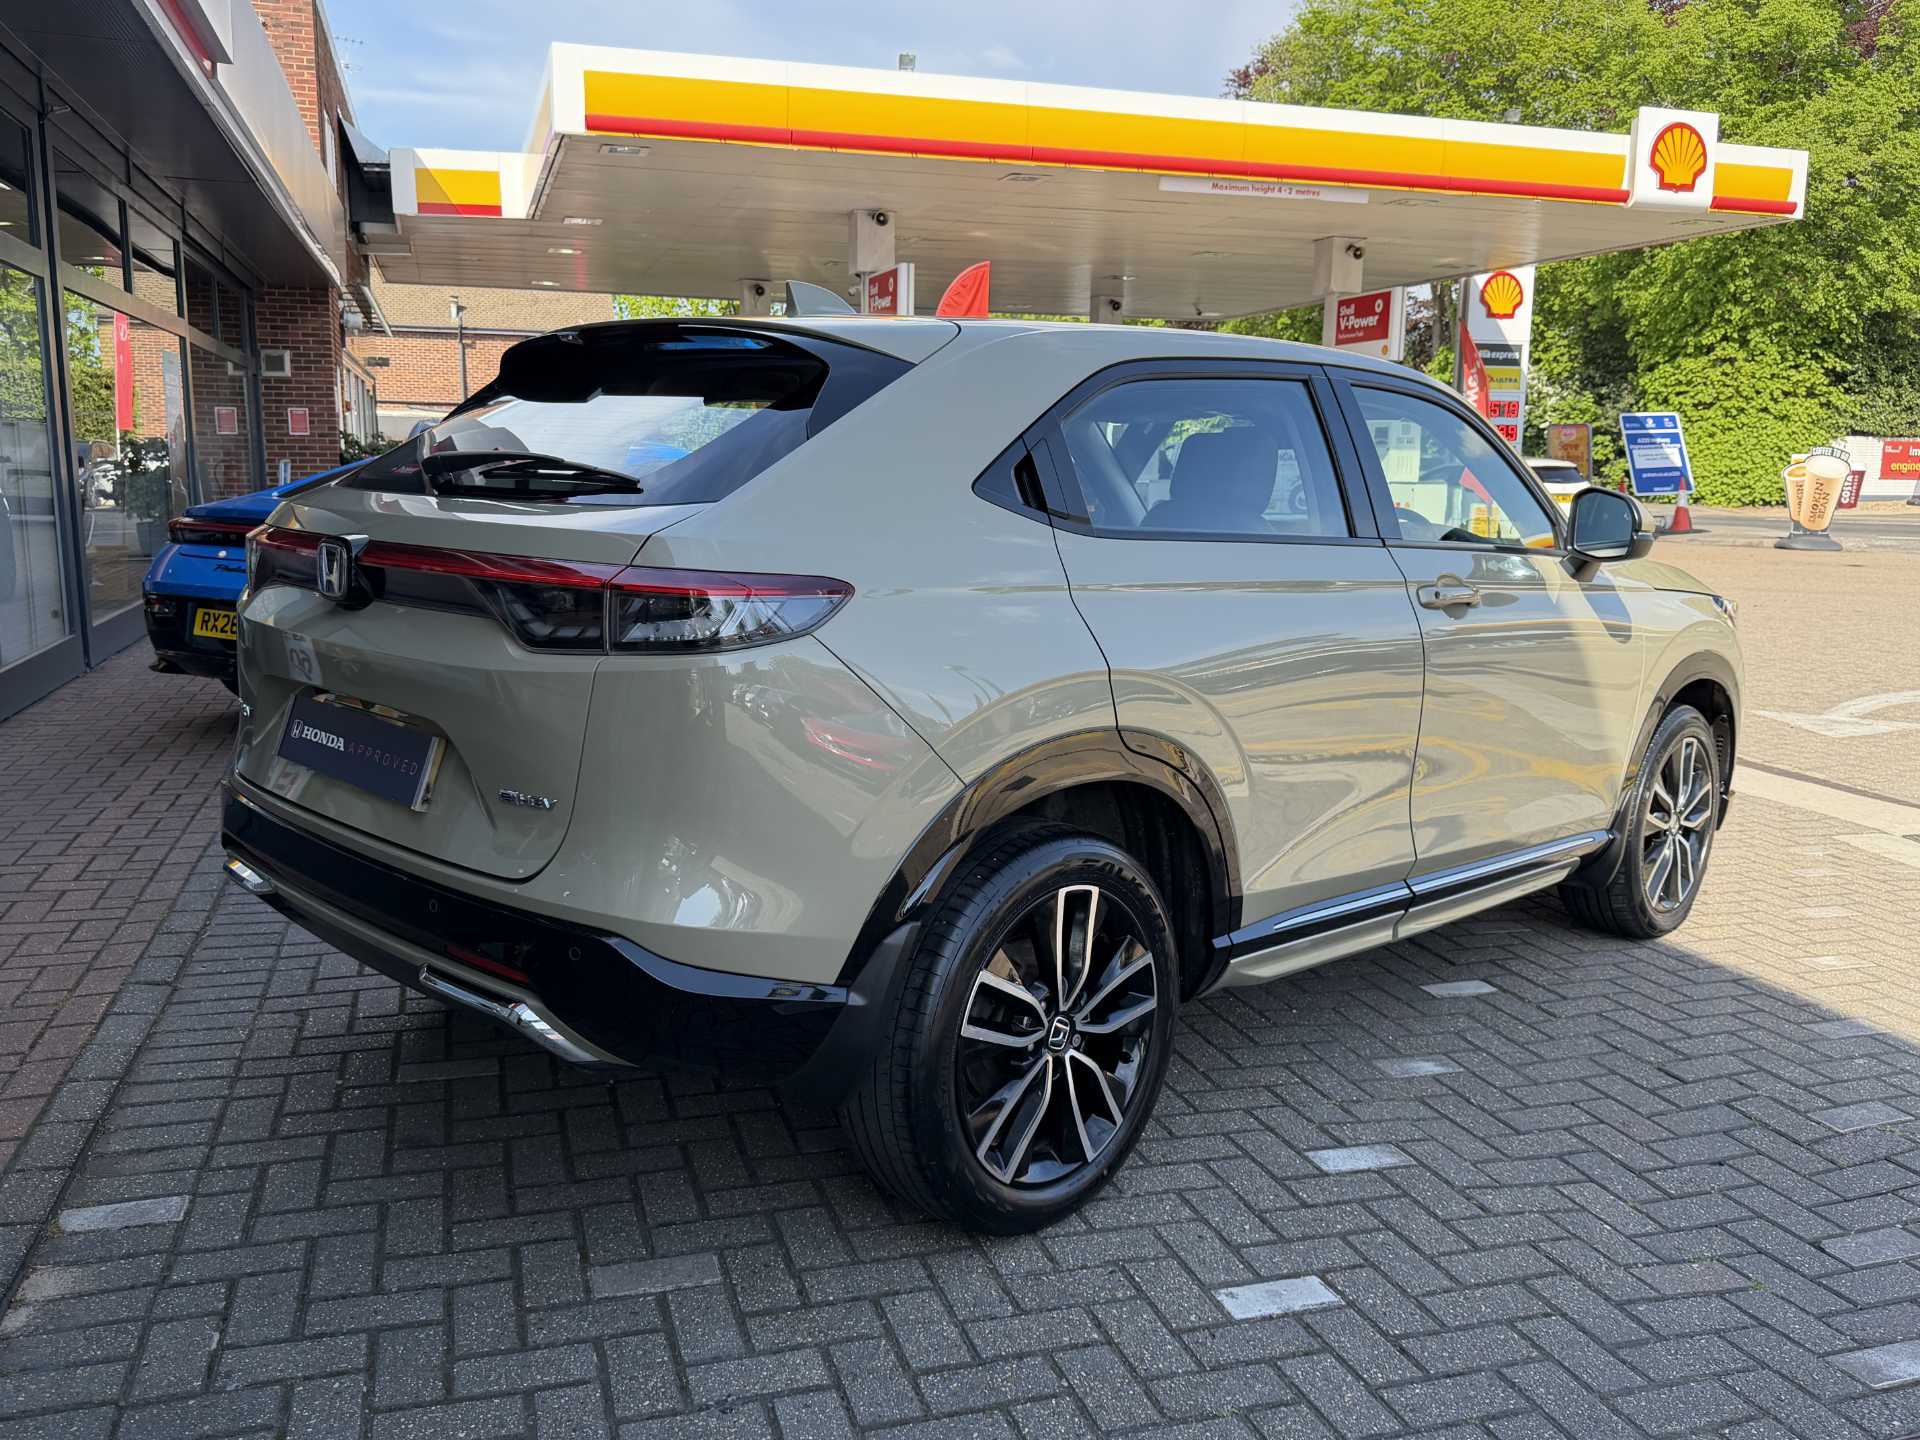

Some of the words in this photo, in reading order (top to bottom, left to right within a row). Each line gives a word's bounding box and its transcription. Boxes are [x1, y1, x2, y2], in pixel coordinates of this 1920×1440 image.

[1211, 182, 1249, 193] Maximum
[1251, 184, 1275, 194] height
[1295, 188, 1321, 197] metres
[1339, 315, 1379, 330] V-Power
[1841, 474, 1854, 504] COSTA
[302, 725, 345, 752] HONDA
